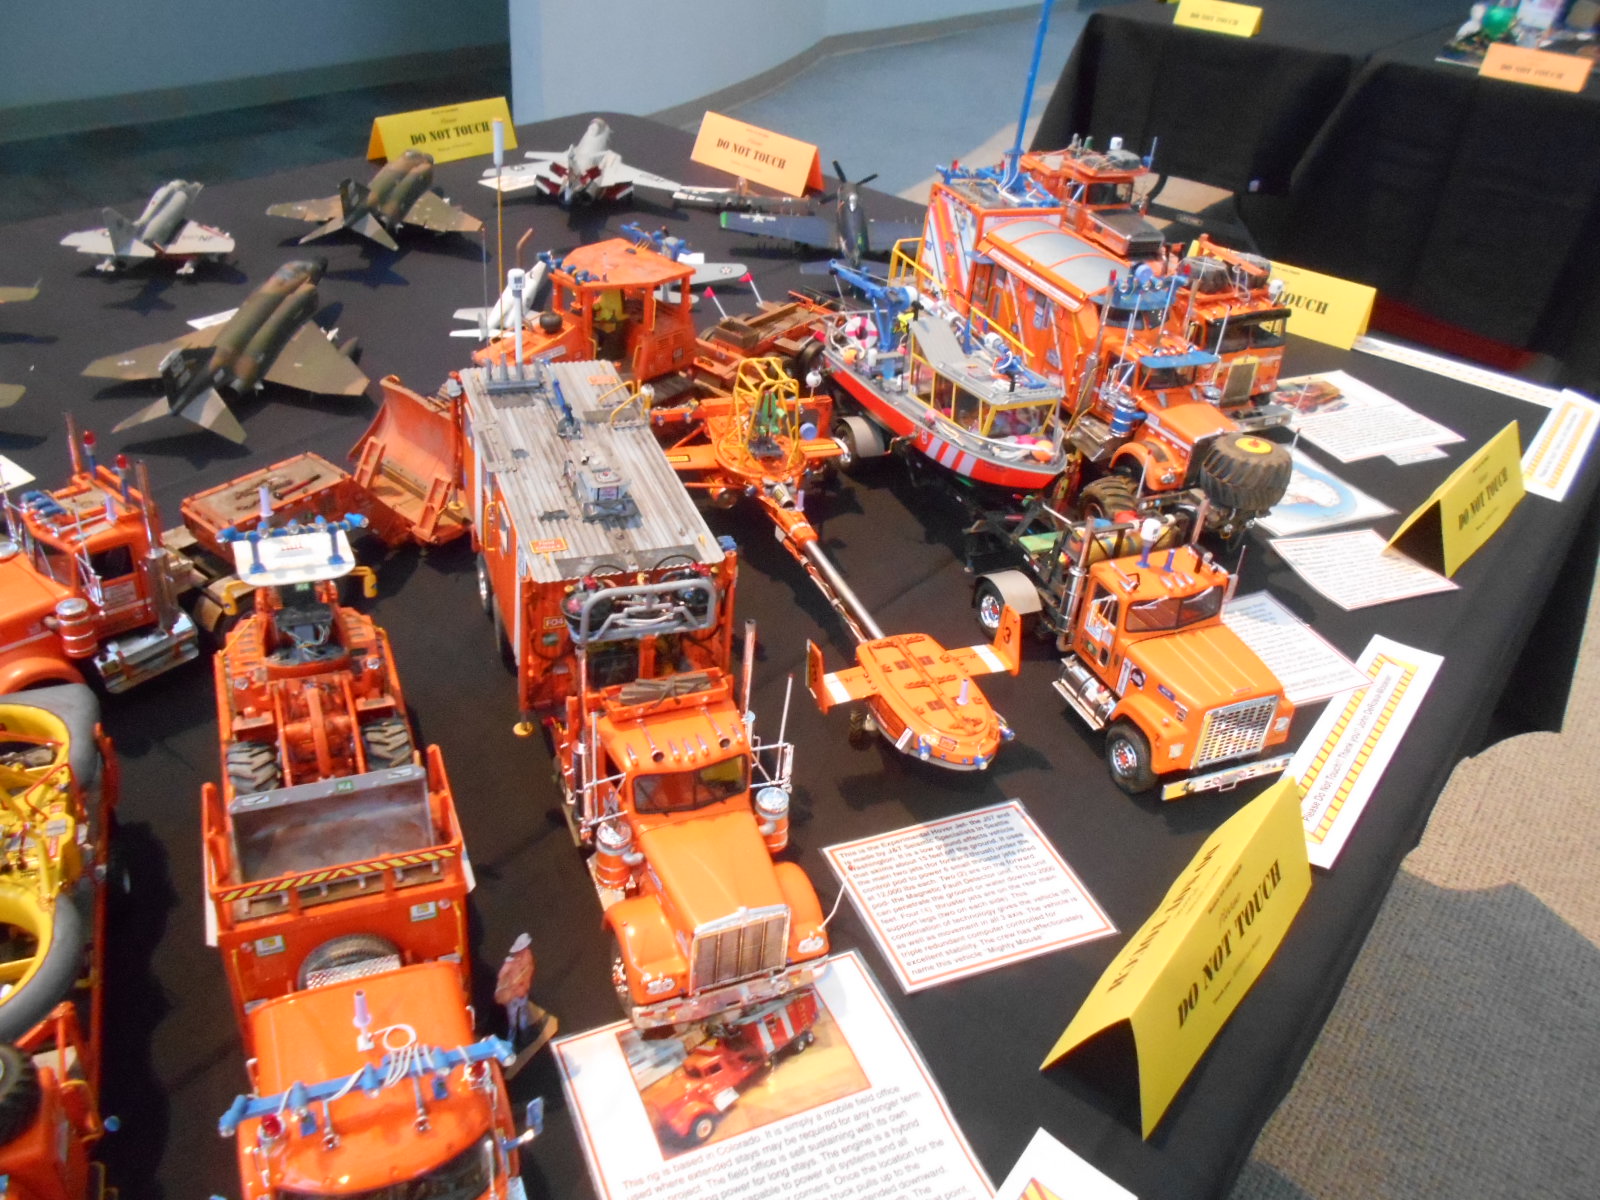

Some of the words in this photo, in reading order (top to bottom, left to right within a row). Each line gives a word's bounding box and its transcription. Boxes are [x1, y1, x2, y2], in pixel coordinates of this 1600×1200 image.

[410, 133, 426, 145] DO
[429, 129, 450, 142] NOT
[454, 121, 490, 137] TOUCH
[717, 138, 730, 150] DO
[732, 143, 751, 157] NOT
[754, 150, 787, 169] TOUCH
[1458, 508, 1470, 531] DO
[1470, 492, 1485, 516] NOT
[1486, 467, 1508, 500] TOUCH
[1004, 629, 1012, 644] 3
[1304, 802, 1320, 821] Please
[1338, 743, 1353, 758] Thank
[1358, 715, 1368, 728] John
[870, 865, 894, 875] skims
[895, 858, 917, 868] about
[1005, 832, 1024, 840] uses
[880, 830, 931, 848] Experimental
[930, 826, 953, 835] Hover
[903, 838, 932, 850] Seismic
[934, 828, 976, 841] Specialists
[983, 820, 1010, 829] Seattle
[934, 838, 962, 851] ground
[962, 833, 988, 843] effects
[988, 826, 1015, 836] vehicle
[871, 873, 892, 882] main
[938, 853, 970, 865] forward
[995, 842, 1017, 851] under
[935, 960, 953, 968] this
[1178, 982, 1198, 1029] DO
[1203, 930, 1232, 990] NOT
[1235, 859, 1282, 939] TOUCH
[622, 1177, 645, 1189] This
[662, 1168, 671, 1176] is
[672, 1155, 704, 1172] based
[705, 1151, 715, 1160] in
[773, 1127, 783, 1136] is
[783, 1116, 814, 1132] simply
[823, 1102, 854, 1118] mobile
[854, 1093, 875, 1106] field
[875, 1086, 900, 1099] office
[654, 1177, 685, 1193] where
[687, 1158, 733, 1181] extended
[734, 1149, 761, 1165] stays
[761, 1141, 782, 1154] may
[783, 1136, 797, 1146] be
[798, 1120, 837, 1140] required
[838, 1116, 851, 1126] for
[853, 1110, 870, 1122] any
[870, 1099, 899, 1114] longer
[900, 1091, 921, 1104] term
[705, 1177, 726, 1187] The
[727, 1167, 749, 1181] field
[750, 1158, 777, 1173] office
[778, 1154, 787, 1163] is
[789, 1145, 807, 1159] self
[807, 1129, 856, 1152] sustaining
[855, 1122, 874, 1134] with
[876, 1117, 888, 1127] its
[888, 1110, 907, 1122] own
[720, 1181, 750, 1200] power
[752, 1175, 766, 1186] for
[767, 1167, 790, 1181] long
[819, 1150, 840, 1161] The
[841, 1137, 873, 1154] engine
[873, 1134, 883, 1142] is
[890, 1118, 920, 1135] hybrid
[781, 1182, 793, 1190] to
[793, 1169, 823, 1188] power
[825, 1163, 837, 1175] all
[838, 1150, 877, 1170] systems
[878, 1141, 896, 1155] and
[897, 1136, 909, 1148] all
[833, 1171, 860, 1185] Once
[860, 1164, 877, 1175] the
[877, 1150, 914, 1169] location
[914, 1144, 928, 1155] for
[928, 1139, 945, 1149] the
[855, 1178, 879, 1193] pulls
[880, 1173, 893, 1182] up
[892, 1169, 904, 1177] to
[904, 1162, 921, 1173] the
[911, 1186, 932, 1197] The
